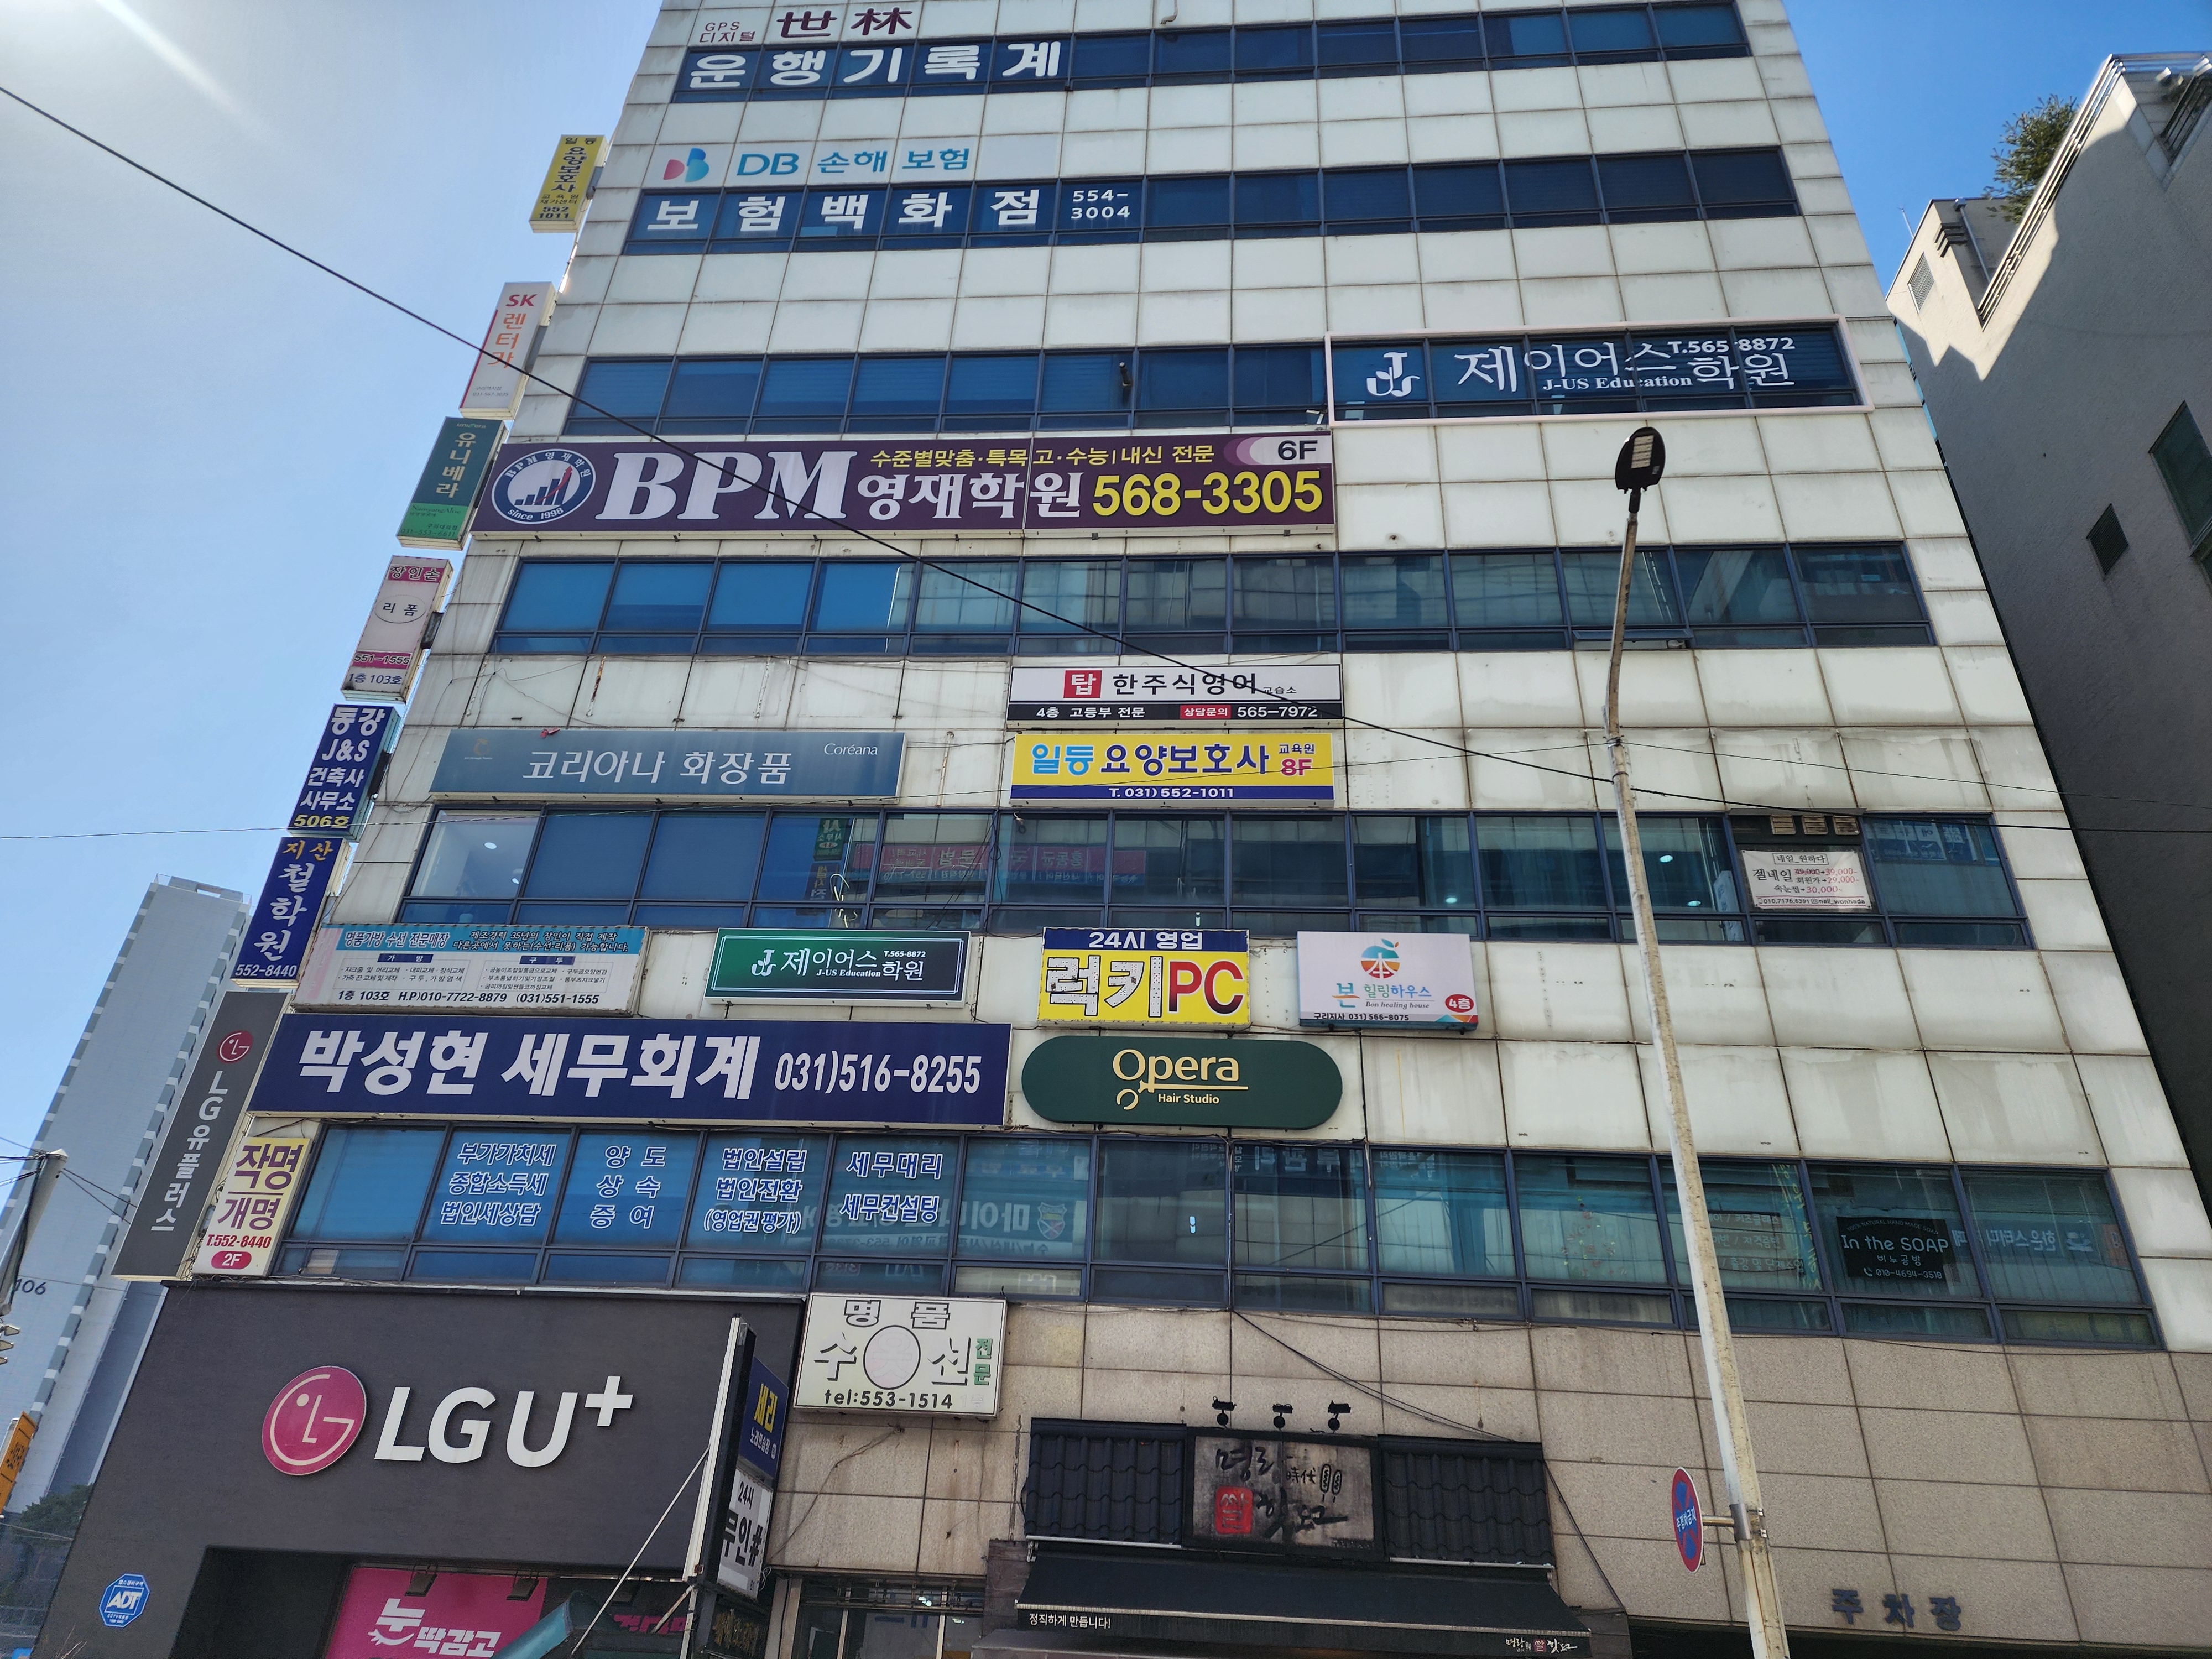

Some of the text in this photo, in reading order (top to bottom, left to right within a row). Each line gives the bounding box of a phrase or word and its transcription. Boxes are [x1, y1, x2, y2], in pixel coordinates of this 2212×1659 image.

[705, 22, 740, 32] GPS
[776, 7, 913, 39] 世林
[699, 30, 755, 43] 디지털
[690, 42, 1061, 88] 운행기록계
[551, 147, 587, 192] 요양보호사
[737, 148, 970, 176] DB 손해 보험
[1071, 190, 1130, 203] 554-
[647, 189, 1040, 231] 보험백화점
[1071, 206, 1131, 220] 3004
[505, 294, 538, 306] SK
[1667, 337, 1797, 354] T.5658872
[1453, 342, 1796, 393] 제이어스 학원
[1542, 378, 1590, 392] J-US
[1171, 445, 1214, 464] 전문
[1277, 440, 1318, 461] 6F
[435, 432, 477, 499] 유니베라
[505, 451, 592, 478] BPM 영재학원
[594, 449, 857, 521] BPM
[857, 470, 1322, 522] 영재학원 568-3305
[507, 507, 565, 521] since 1998
[354, 654, 410, 665] 551-1555
[348, 673, 403, 685] 1층 103호
[1071, 674, 1096, 695] 탑
[1112, 672, 1256, 696] 한주식영어
[331, 707, 386, 736] 동강
[1036, 706, 1318, 718] 4층 고등부 전문 상담문의 565-7972
[321, 739, 370, 762] J&S
[822, 742, 878, 757] Coréana
[1031, 743, 1316, 776] 일등 요양보호사 교육원
[307, 767, 365, 788] 건축사
[523, 749, 792, 785] 코리아나 화장품
[1281, 758, 1313, 776] 8F
[300, 791, 355, 811] 사무소
[294, 815, 350, 828] 506호
[282, 839, 333, 861] 지산
[254, 862, 315, 961] 철학원
[345, 931, 450, 949] 명품가방 수선 전문매장
[470, 931, 618, 942] 제조경력 35년의 장인이 직접 제작
[1088, 931, 1203, 950] 24시 영업
[780, 947, 924, 982] 제이어스 학원
[884, 950, 926, 958] T.565-8872
[234, 964, 298, 977] 552-8440
[816, 968, 881, 978] J-US Education
[338, 990, 355, 1000] 1층
[360, 991, 390, 1001] 103호
[1046, 954, 1244, 1018] 럭키PC
[1364, 984, 1432, 999] 힐링하우스
[1381, 1001, 1407, 1010] healing
[1448, 998, 1471, 1010] 4층
[1313, 1013, 1345, 1021] 구리지사
[298, 1029, 983, 1099] 박성현 세무회계 031)516-8255
[1112, 1048, 1240, 1093] Opera
[1157, 1093, 1220, 1105] Hair Studio
[457, 1142, 557, 1166] 부가가치세
[722, 1147, 808, 1174] 법인설립
[234, 1144, 304, 1190] 작명
[846, 1151, 944, 1181] 세무대리
[448, 1171, 549, 1197] 종합소득세
[715, 1177, 804, 1204] 법인전환
[217, 1197, 283, 1231] 개명
[440, 1201, 541, 1227] 법인세상담
[839, 1193, 940, 1224] 세무컨설팅
[206, 1234, 273, 1249] T.552-8440
[1841, 1234, 1860, 1249] In
[1864, 1235, 1895, 1251] the
[1900, 1237, 1949, 1253] SOAP
[222, 1253, 242, 1267] 2F
[973, 1338, 993, 1386] 전문
[825, 1389, 953, 1409] tel:553-1514
[738, 1480, 754, 1510] 24시
[1676, 1506, 1697, 1532] 주정차금지
[107, 1591, 142, 1610] ADT
[1832, 1588, 1962, 1631] 주차장
[1029, 1613, 1111, 1629] 정직하게 만듭니다!
